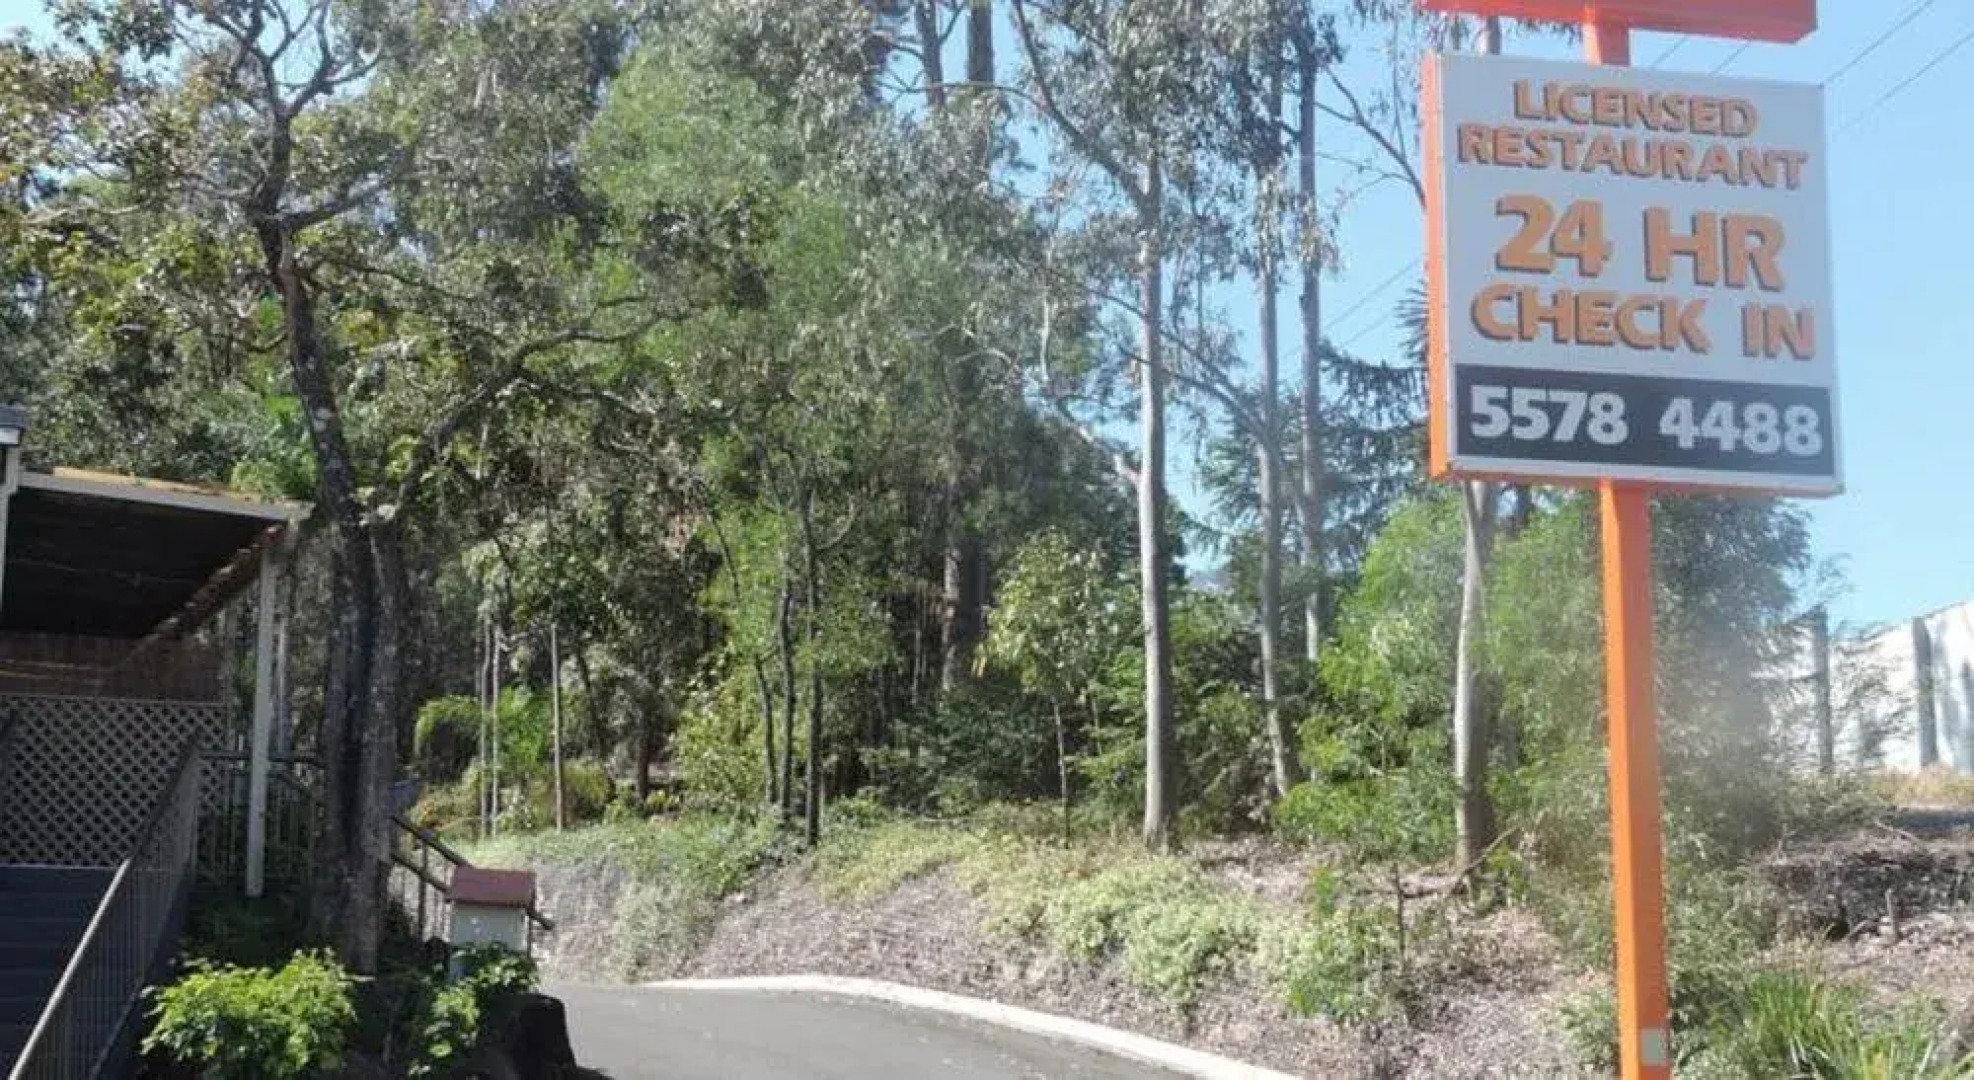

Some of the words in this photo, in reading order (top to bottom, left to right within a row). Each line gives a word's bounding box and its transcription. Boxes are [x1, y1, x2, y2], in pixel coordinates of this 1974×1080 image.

[1514, 79, 1757, 137] LICENSED
[1457, 124, 1807, 190] RESTAURANT
[1496, 194, 1613, 277] 24
[1643, 206, 1785, 292] HR
[1471, 283, 1711, 354] CHECK
[1741, 304, 1815, 361] IN
[1470, 385, 1628, 446] 5578
[1659, 398, 1823, 457] 4488
